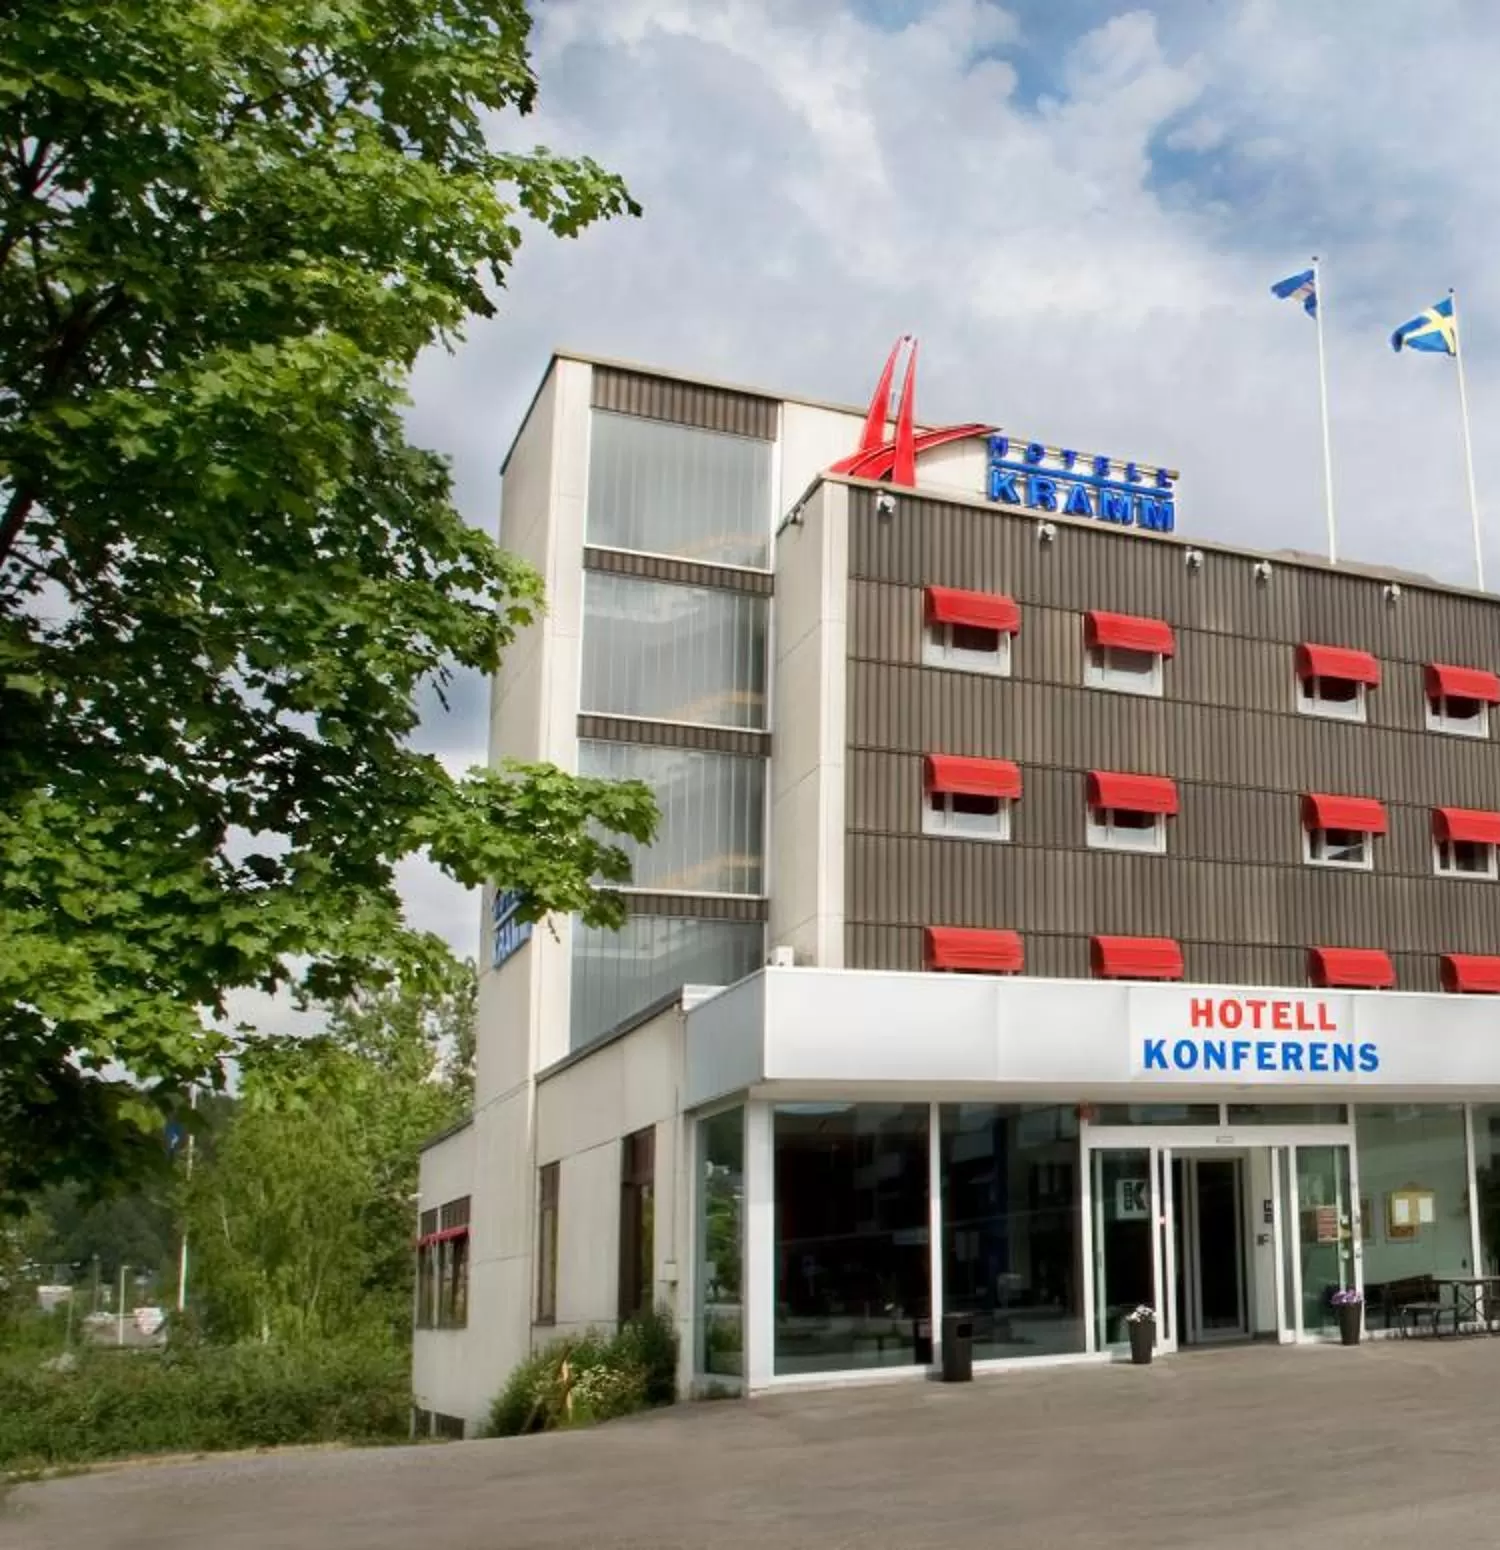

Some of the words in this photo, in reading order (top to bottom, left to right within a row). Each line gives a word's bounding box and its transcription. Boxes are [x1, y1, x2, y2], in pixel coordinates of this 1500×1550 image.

[988, 435, 1173, 489] HOTELL
[988, 466, 1175, 533] KRAMM
[1190, 998, 1337, 1032] HOTELL
[1143, 1039, 1380, 1073] KONFERENS
